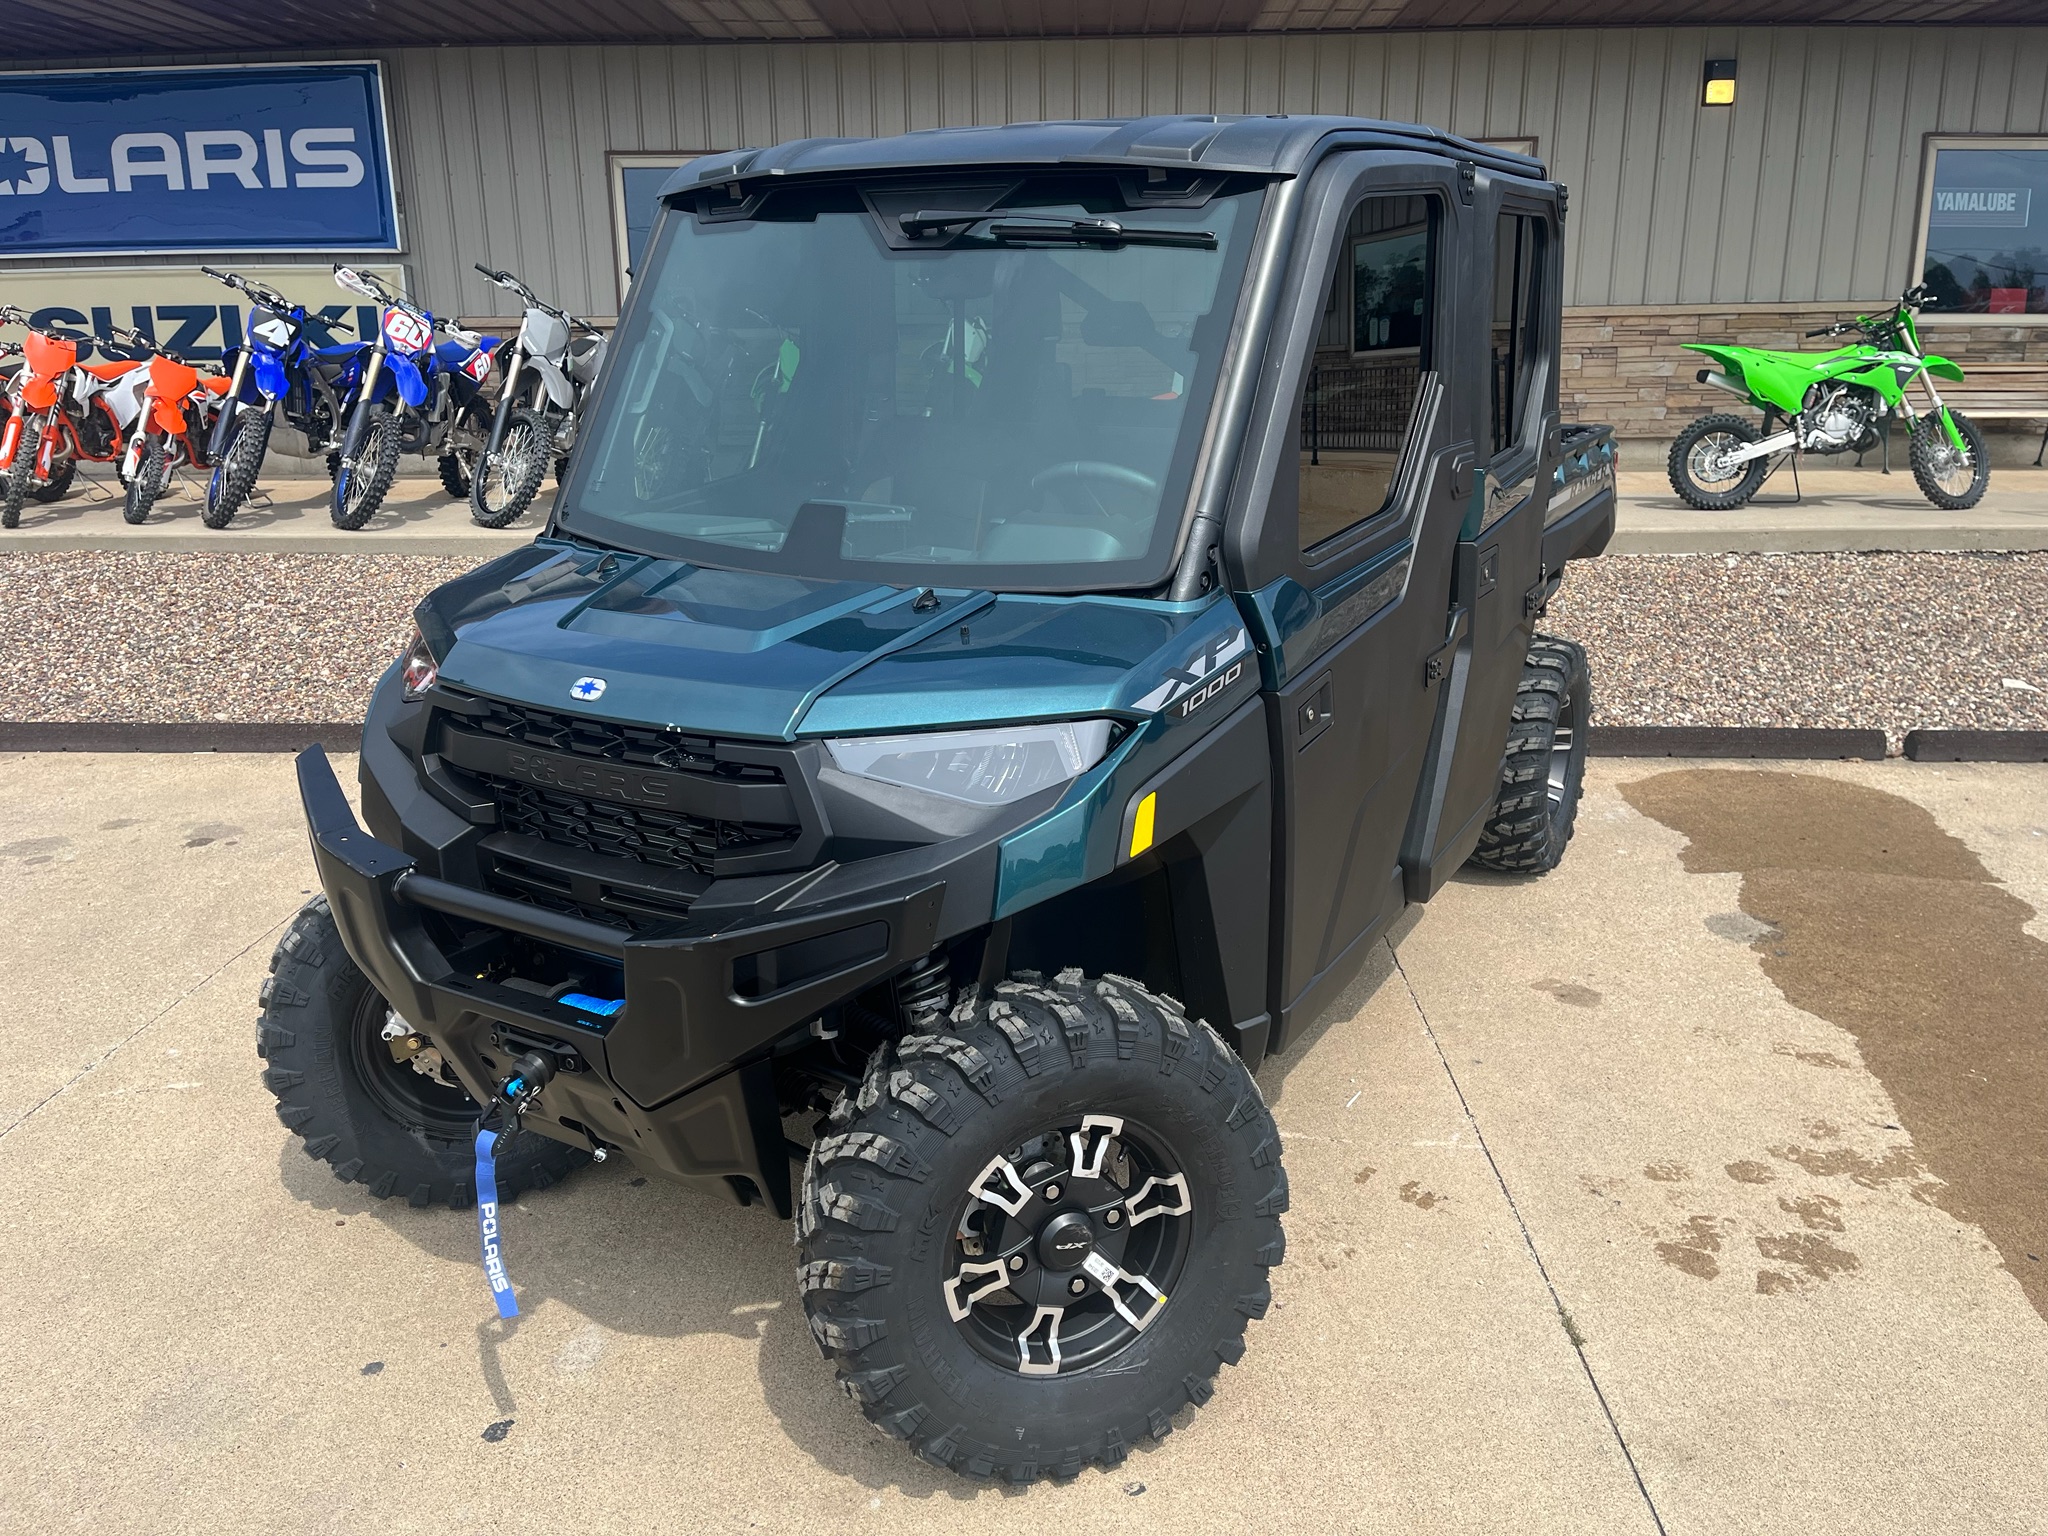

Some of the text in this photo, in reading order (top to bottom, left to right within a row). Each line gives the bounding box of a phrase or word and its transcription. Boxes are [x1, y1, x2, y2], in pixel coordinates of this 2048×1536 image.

[1937, 192, 2017, 212] YAMALUBE
[253, 318, 297, 348] 4
[385, 312, 431, 348] 60
[473, 352, 491, 382] 60
[1158, 625, 1241, 708] XP
[1182, 662, 1242, 717] 1000
[507, 749, 672, 805] POLARIS
[481, 1202, 509, 1293] POLARIS
[1056, 1241, 1088, 1250] XP
